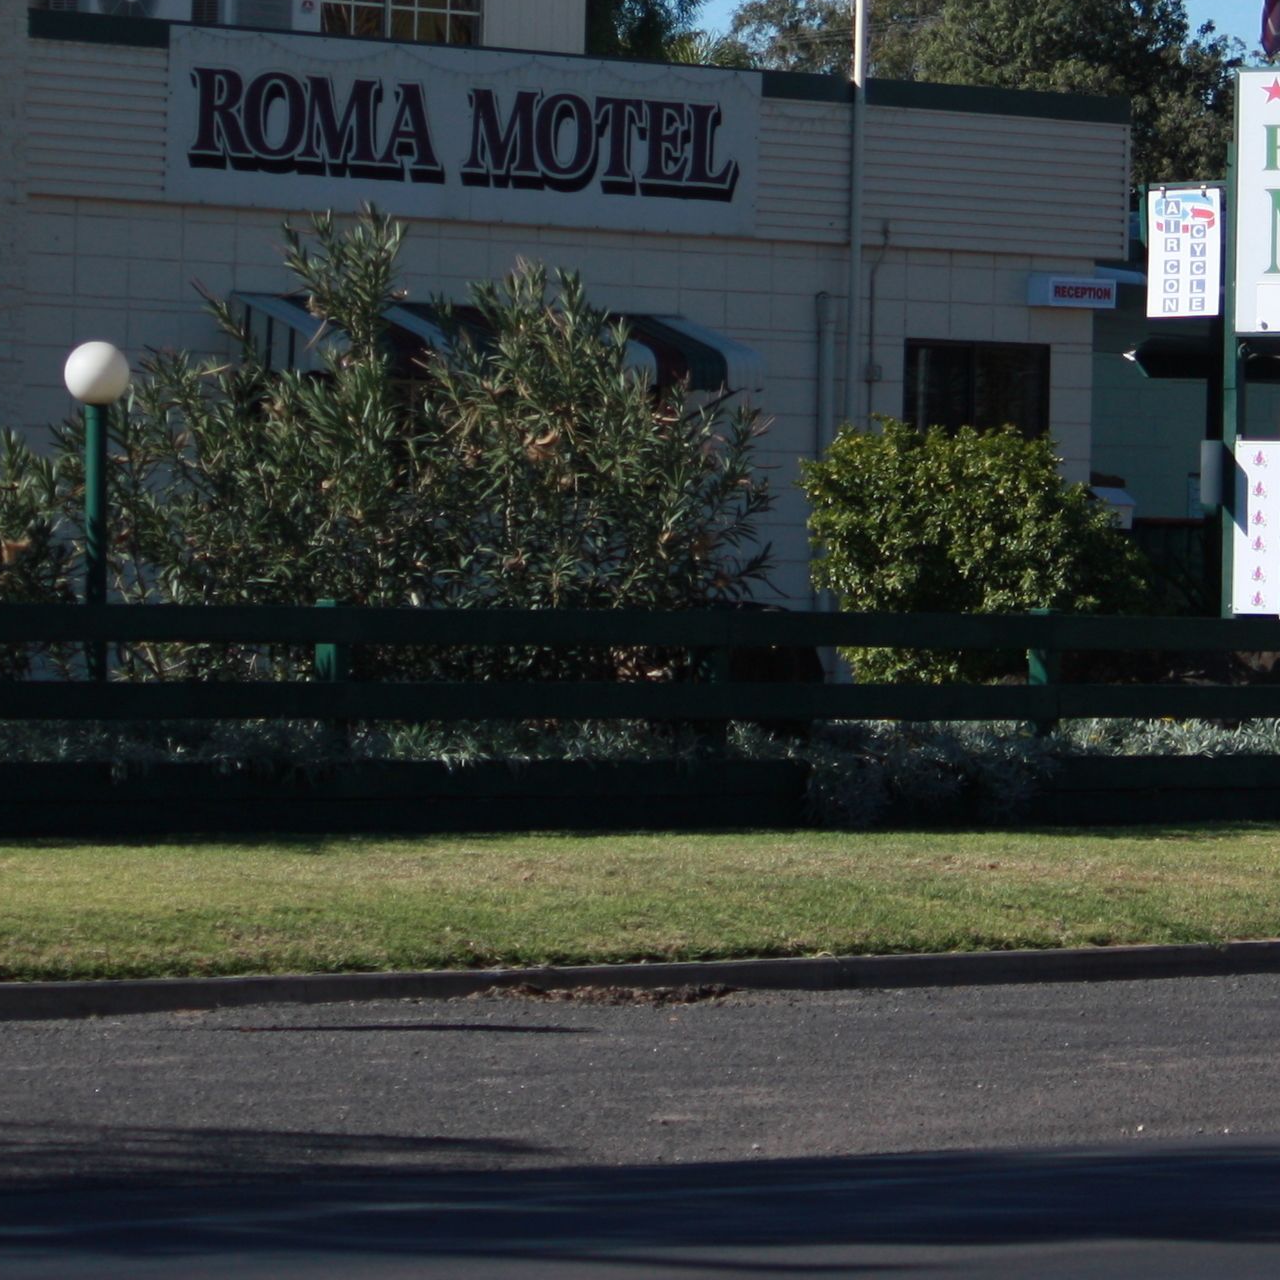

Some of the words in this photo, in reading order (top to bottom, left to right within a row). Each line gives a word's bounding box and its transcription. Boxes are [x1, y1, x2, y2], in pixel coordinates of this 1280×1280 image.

[188, 66, 445, 184] ROMA
[460, 87, 740, 203] MOTEL
[1054, 286, 1111, 300] RECEPTION
[1189, 224, 1206, 311] CYCLE
